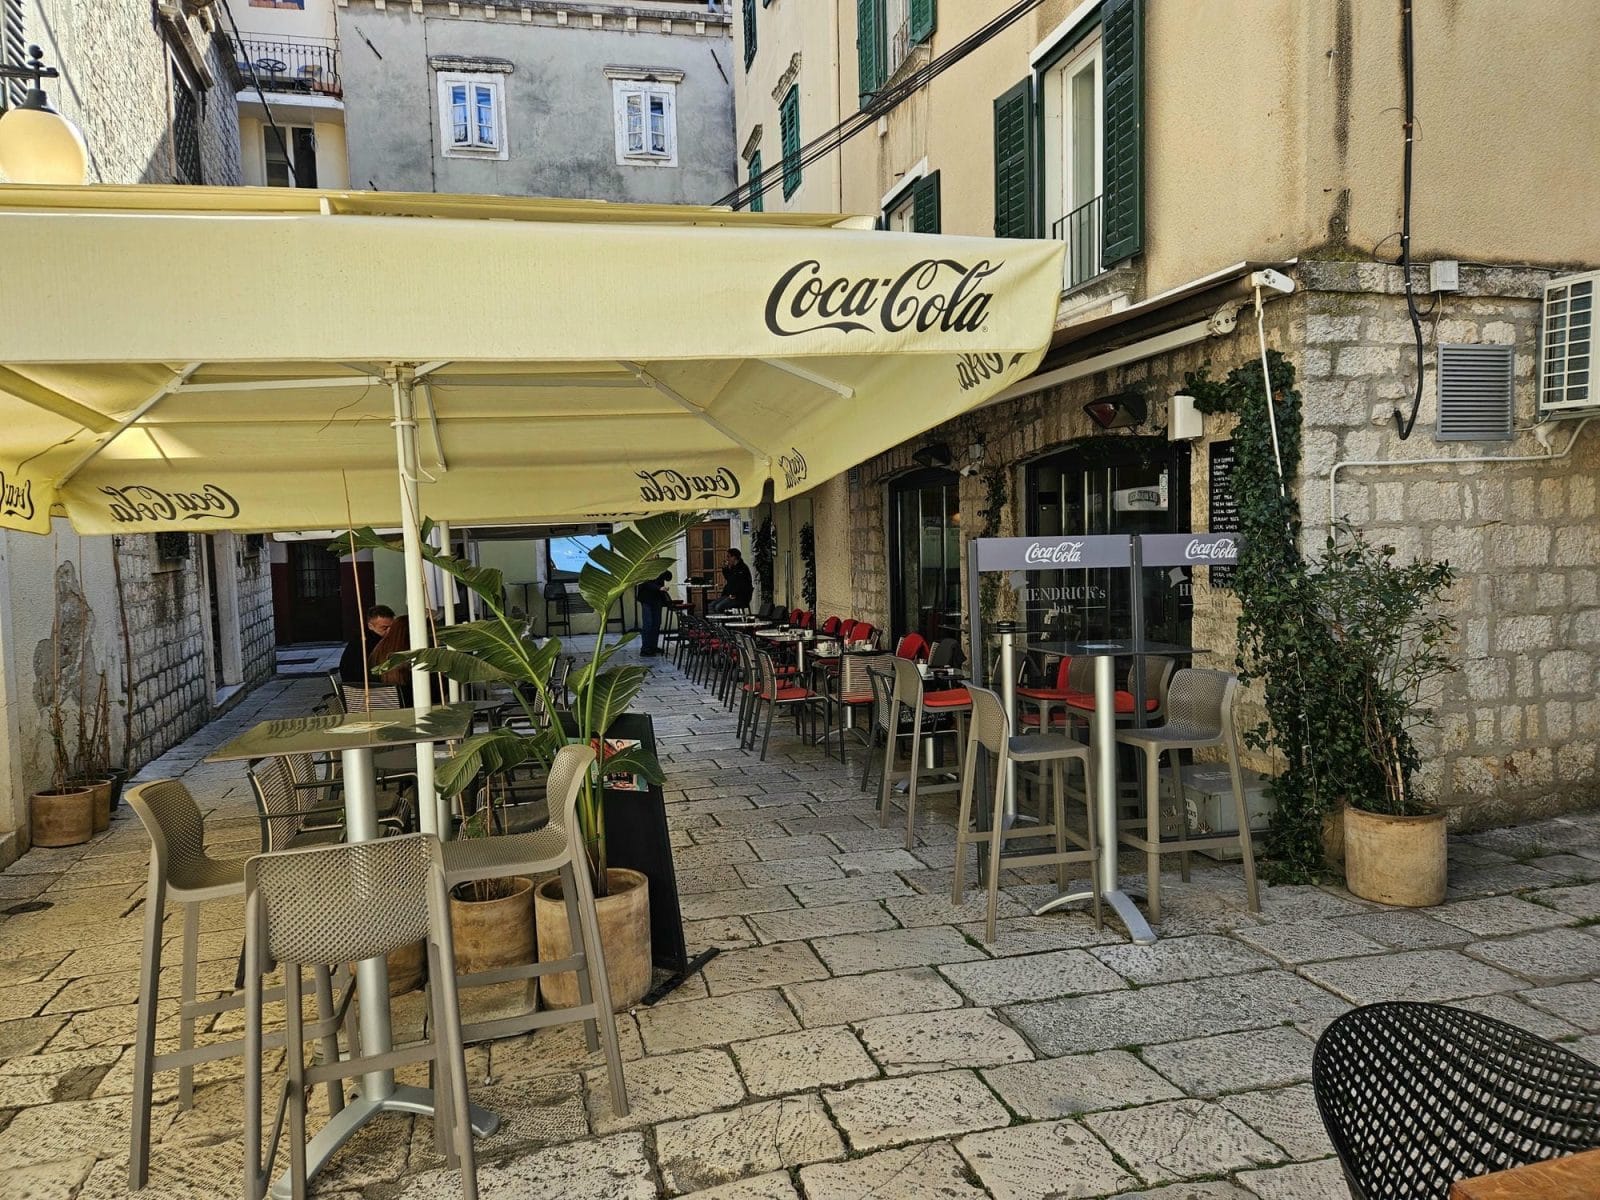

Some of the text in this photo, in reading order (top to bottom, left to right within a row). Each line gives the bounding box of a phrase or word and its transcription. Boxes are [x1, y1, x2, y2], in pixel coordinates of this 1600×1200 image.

[765, 259, 1006, 337] Coca-Cola
[1024, 541, 1085, 564] Coca-Cola
[1185, 538, 1238, 559] Coca-Cola
